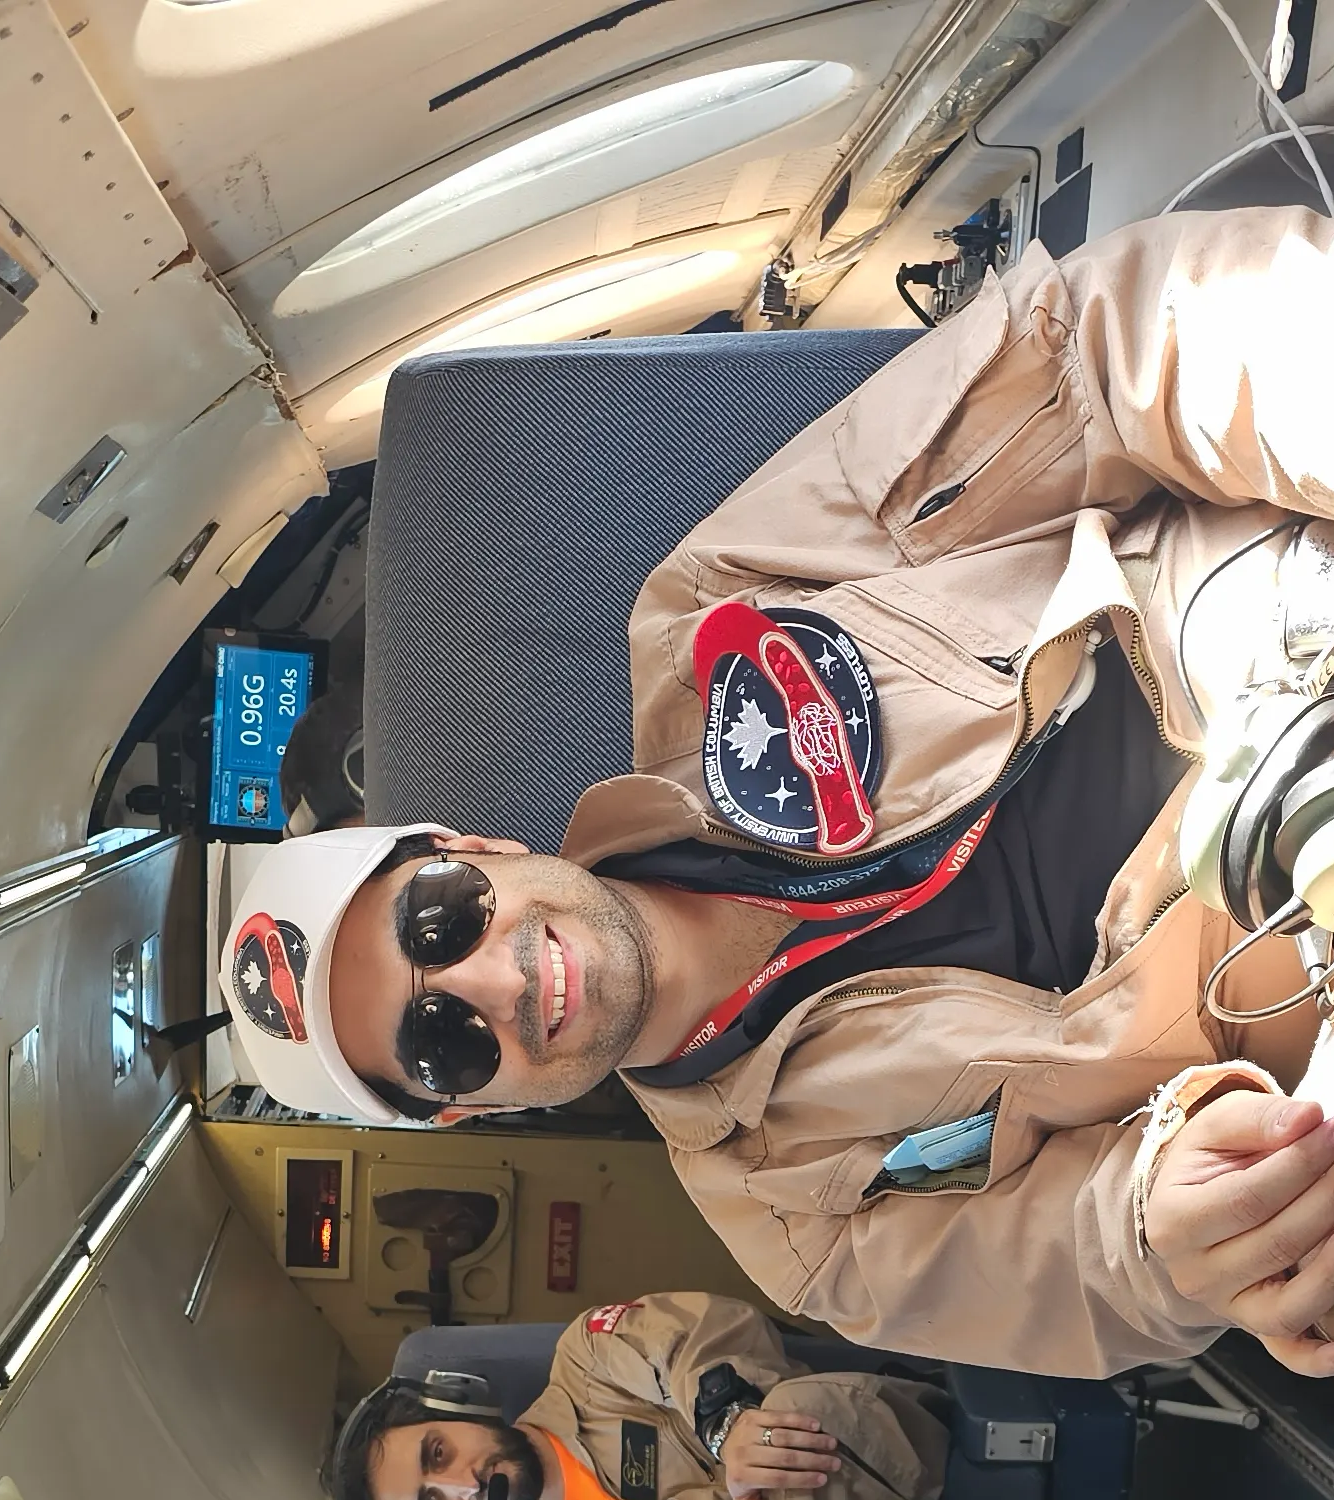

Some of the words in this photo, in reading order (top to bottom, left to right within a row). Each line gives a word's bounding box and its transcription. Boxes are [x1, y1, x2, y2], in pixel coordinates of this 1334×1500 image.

[836, 632, 874, 702] CLOT-LESS
[240, 674, 265, 746] 0.96G
[278, 668, 298, 716] 20.4s
[704, 682, 725, 753] COLUMBIA
[703, 757, 727, 804] BRITISH
[717, 796, 735, 815] OF
[729, 807, 801, 845] UNIVERSITY
[747, 955, 788, 996] VISITOR
[552, 1217, 573, 1278] EXIT
